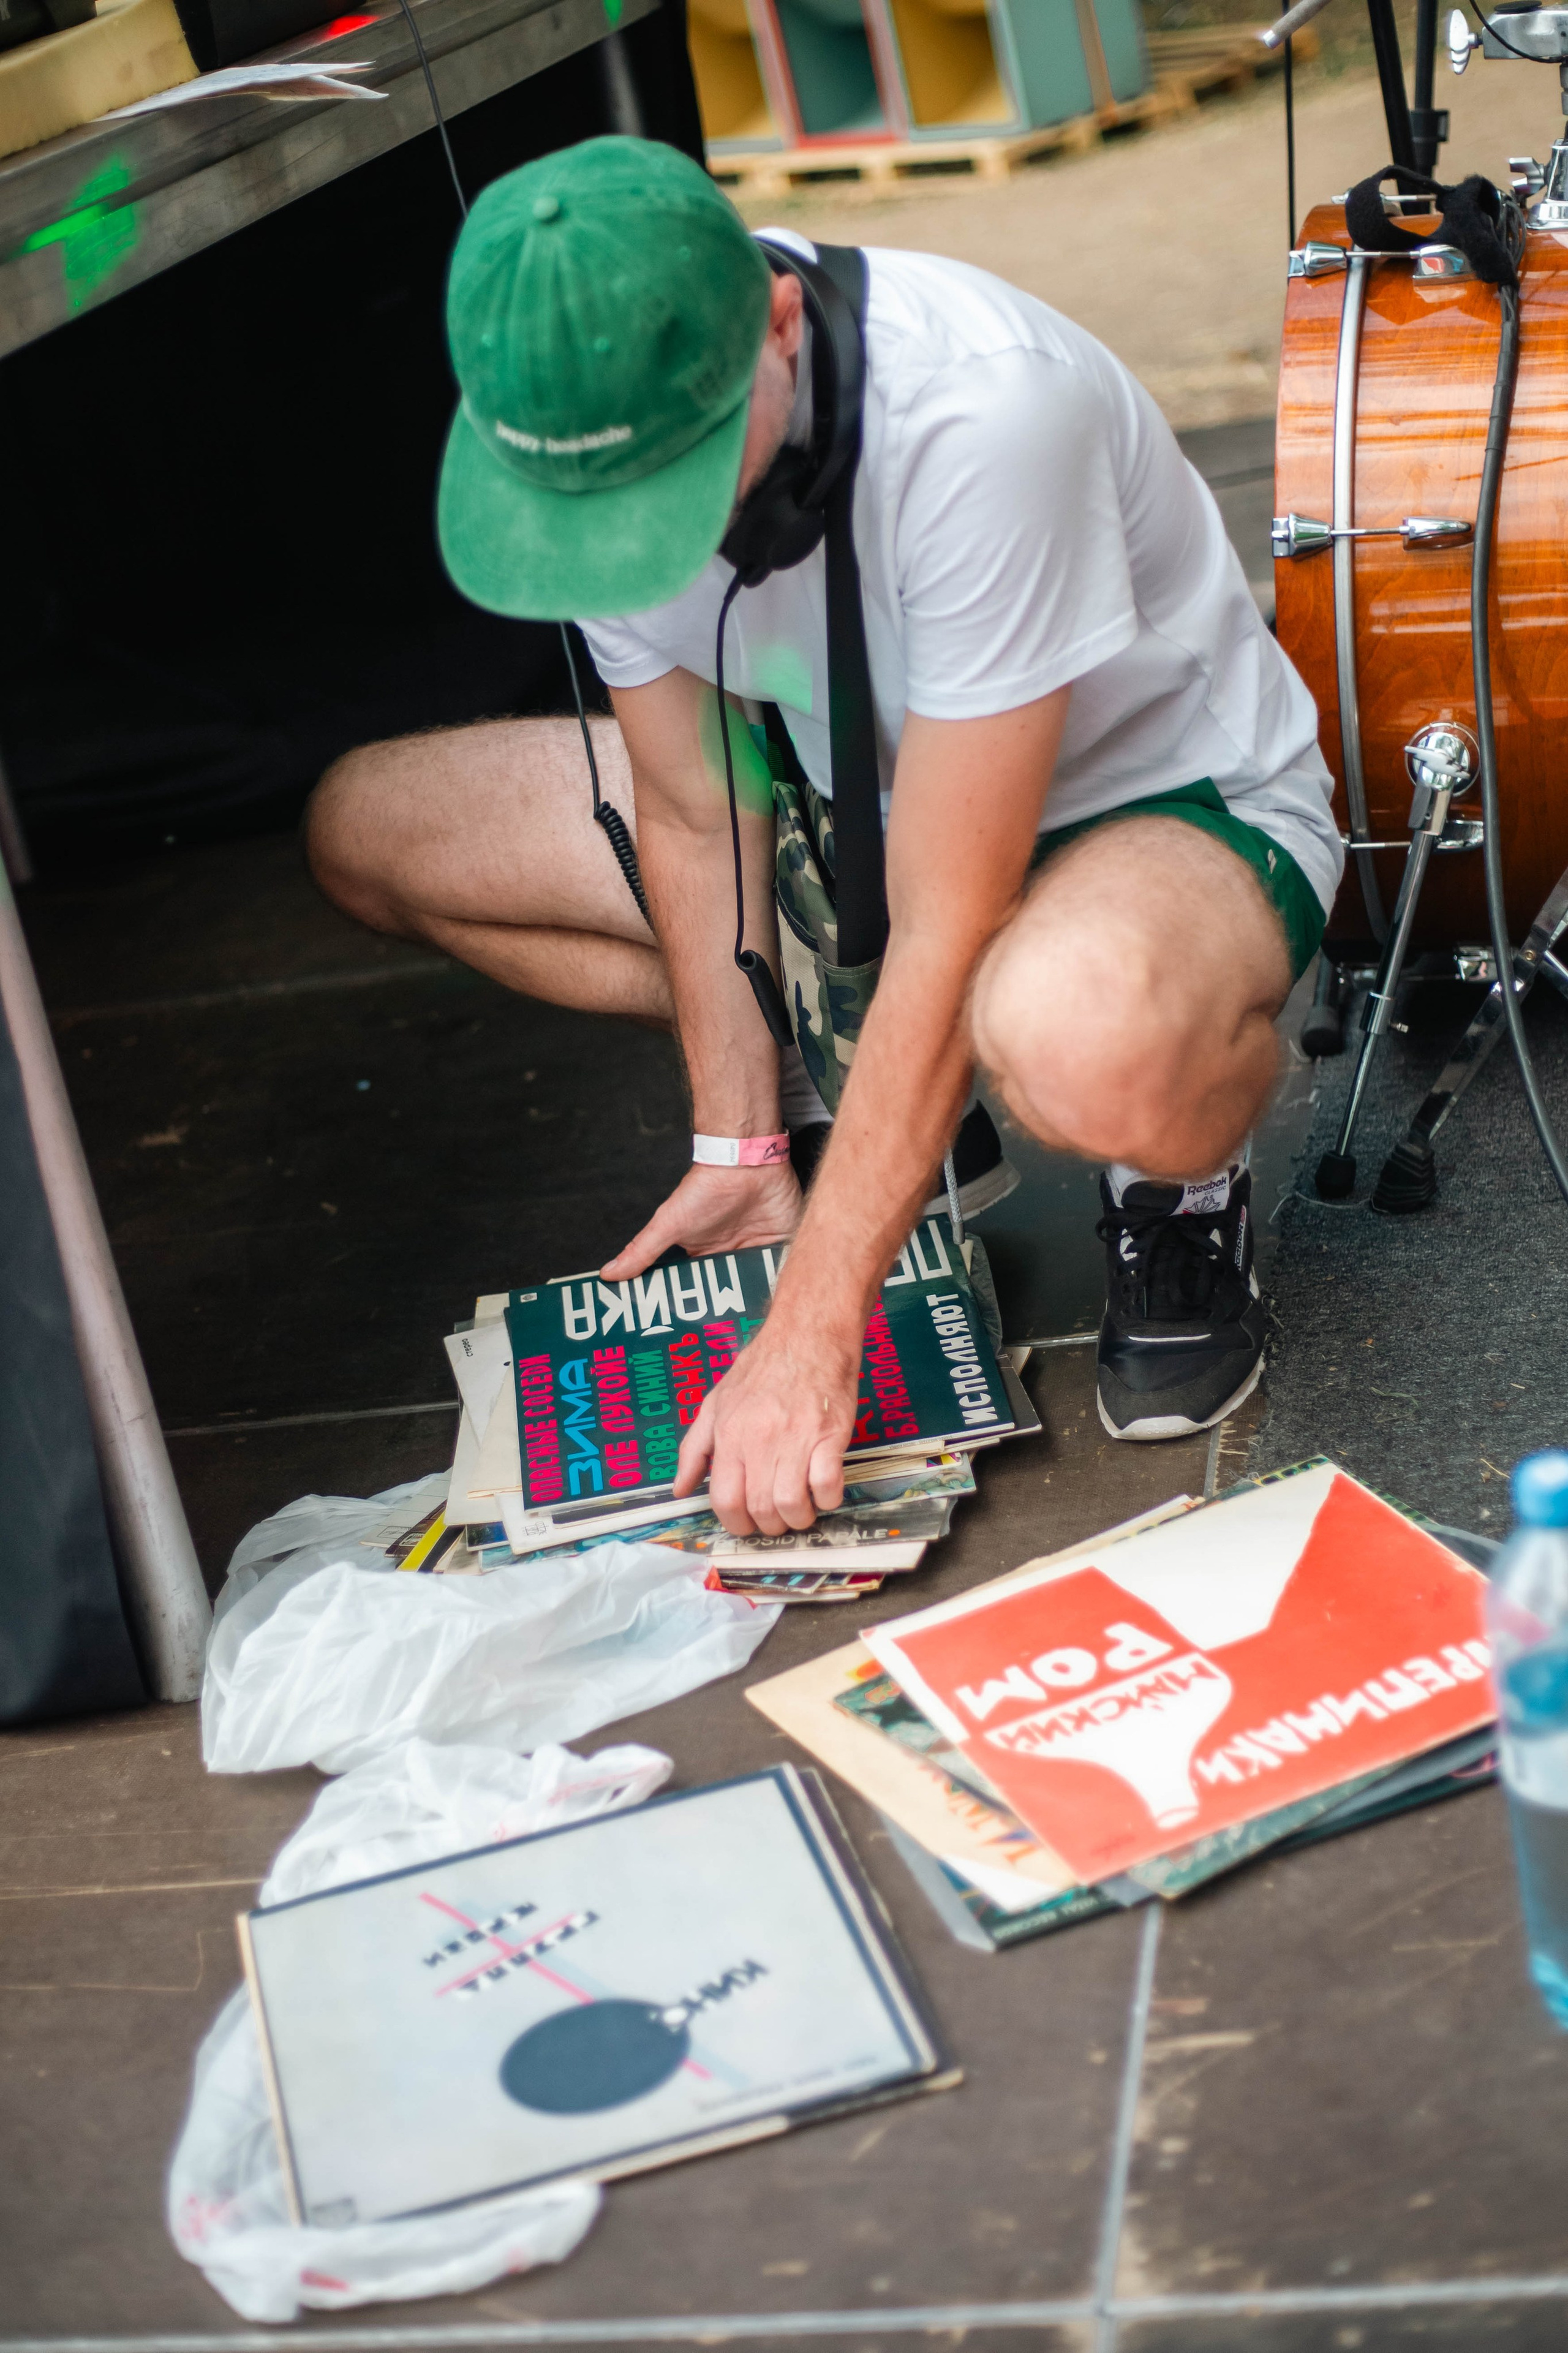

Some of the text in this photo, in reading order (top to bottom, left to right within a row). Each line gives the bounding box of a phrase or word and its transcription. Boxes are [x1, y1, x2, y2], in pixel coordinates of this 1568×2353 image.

[1187, 1176, 1227, 1196] Reebok
[1204, 1185, 1226, 1196] CLASSIC
[1235, 1223, 1245, 1271] eebok
[561, 1255, 746, 1341] МАЙКА
[461, 1338, 473, 1357] стерео
[669, 1333, 708, 1426] БАНКЪ
[925, 1294, 998, 1425] ИСПОЛНЯЮТ
[524, 1419, 564, 1502] ОПАСНЫЕ
[559, 1358, 605, 1496] ЗИМА
[590, 1345, 642, 1487] ОЛЕ ЛУКОЙЕ
[628, 1350, 679, 1480] ВОВА СИНИЙ
[954, 1623, 1174, 1721] РОМ
[998, 1660, 1221, 1751] МАЙСКИЙ
